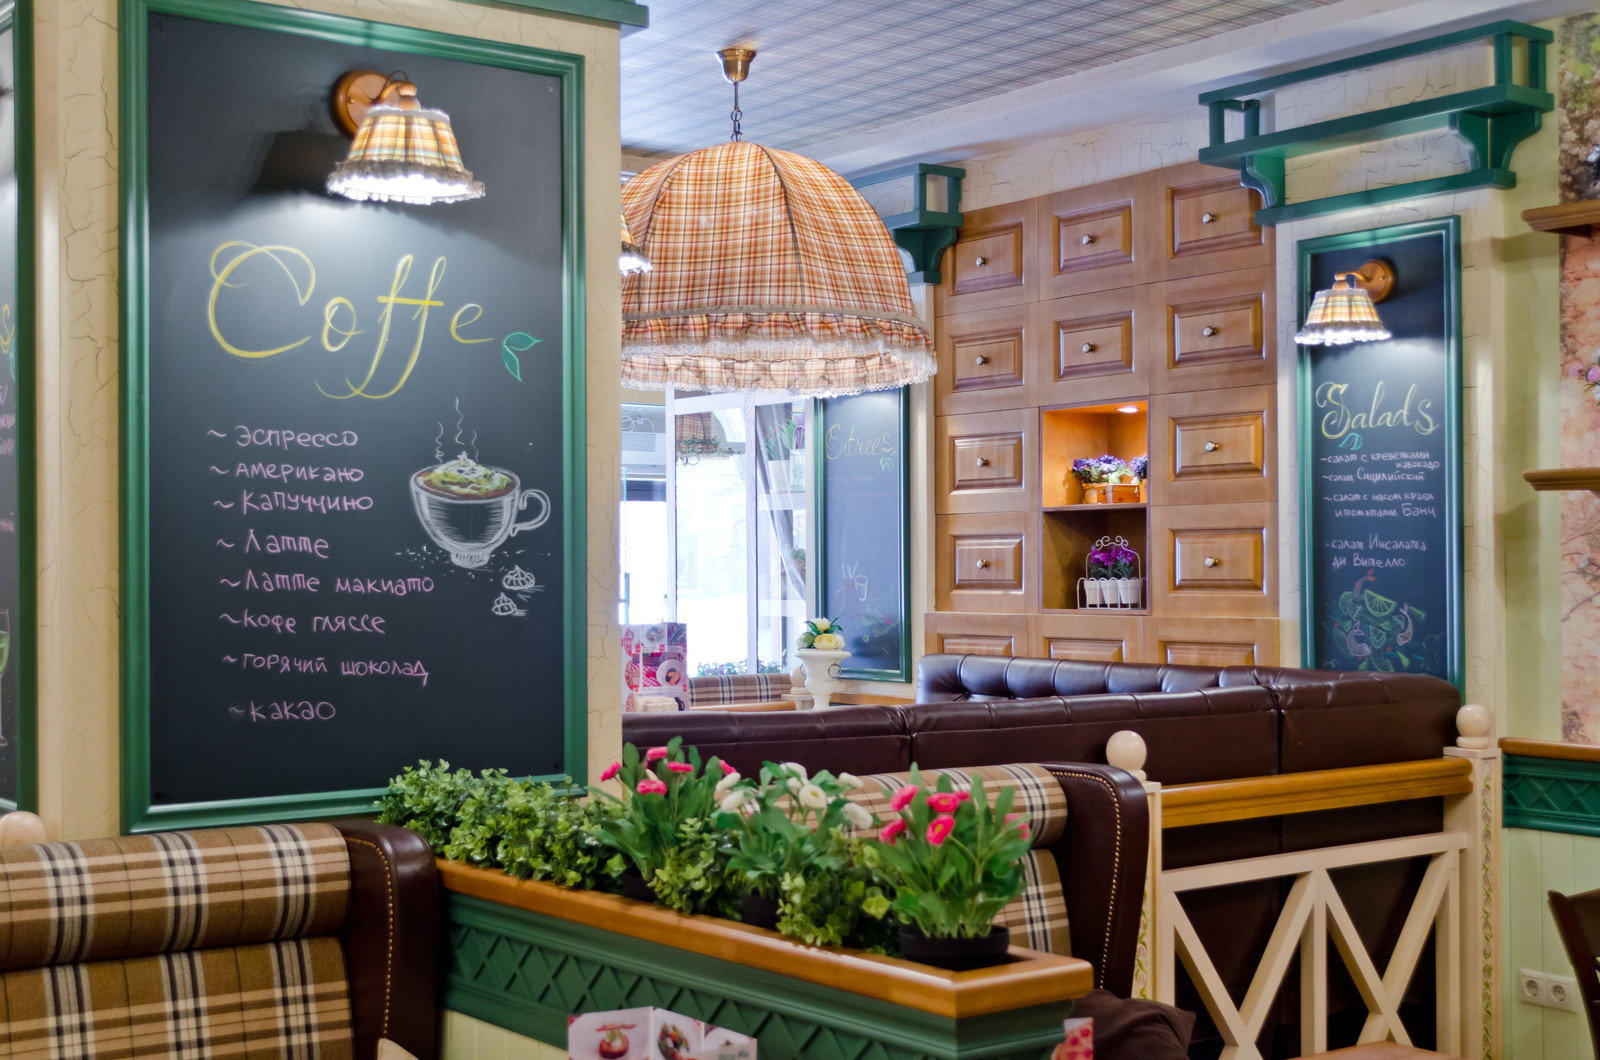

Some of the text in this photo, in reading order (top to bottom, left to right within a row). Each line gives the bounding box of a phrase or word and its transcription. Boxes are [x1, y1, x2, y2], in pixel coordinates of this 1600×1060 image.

[208, 240, 495, 399] Coffe
[1315, 380, 1440, 440] Salads
[234, 425, 359, 450] Эспрессо
[246, 528, 330, 559] Латте
[246, 568, 435, 596] Латте макиато
[312, 613, 386, 634] гляссе
[340, 659, 430, 687] шоколад
